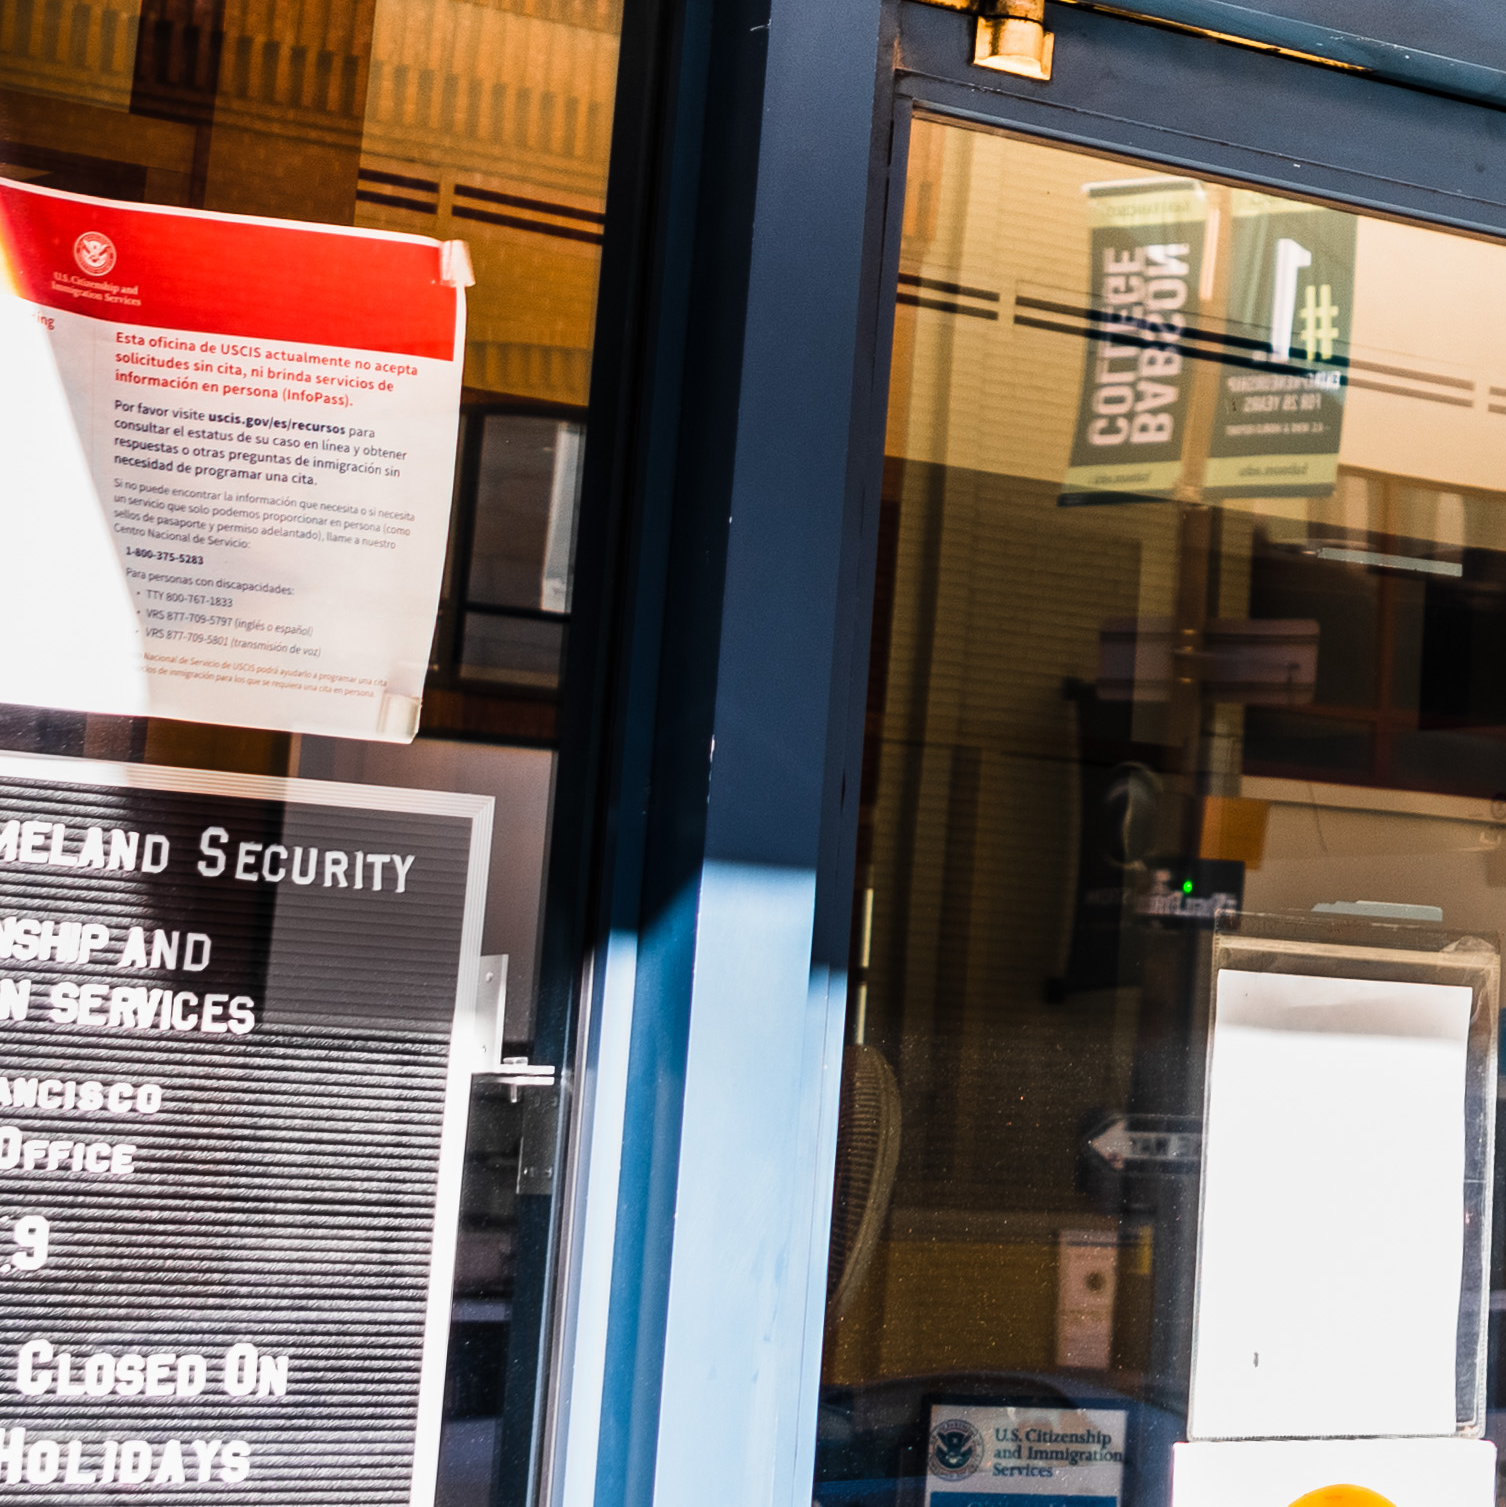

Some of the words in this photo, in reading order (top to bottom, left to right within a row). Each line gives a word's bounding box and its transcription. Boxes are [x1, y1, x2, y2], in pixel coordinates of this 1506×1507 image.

[105, 295, 141, 306] Services
[121, 286, 138, 295] and
[115, 352, 189, 370] solicitudes
[193, 361, 213, 372] sin
[217, 362, 247, 378] cita,
[251, 367, 263, 377] ni
[268, 367, 311, 383] brinda
[316, 375, 374, 389] servicios
[378, 380, 394, 391] de
[116, 332, 145, 346] Esta
[149, 337, 196, 351] oficina
[200, 342, 217, 353] de
[221, 344, 261, 359] USCIS
[265, 350, 351, 368] actualmente
[355, 360, 371, 370] no
[375, 361, 418, 375] acepta
[115, 369, 198, 390] información
[202, 383, 218, 392] en
[222, 385, 278, 399] persona
[283, 387, 353, 408] (InfoPass).
[115, 400, 134, 412] Por
[138, 403, 169, 417] favor
[172, 408, 205, 421] visite
[208, 412, 346, 435] uscis.gov/es/recursos
[349, 427, 375, 438] para
[115, 419, 170, 434] consultar
[173, 427, 184, 437] el
[188, 429, 233, 441] estatus
[237, 432, 251, 443] de
[256, 436, 269, 445] su
[273, 437, 300, 447] caso
[304, 440, 318, 450] en
[322, 440, 350, 453] línea
[353, 446, 360, 456] y
[363, 446, 407, 460] obtener
[115, 437, 178, 454] respuestas
[182, 447, 189, 456] o
[193, 447, 225, 458] otras
[228, 449, 292, 464] preguntas
[295, 455, 310, 466] de
[313, 457, 381, 475] inmigración
[385, 466, 400, 477] sin
[114, 455, 173, 472] necesidad
[177, 462, 192, 473] de
[195, 466, 262, 480] programar
[266, 472, 288, 482] una
[292, 472, 317, 485] cita.
[114, 478, 123, 488] Si
[125, 482, 137, 490] no
[139, 484, 170, 494] puede
[172, 489, 221, 501] encontrar
[224, 492, 233, 501] la
[235, 493, 297, 507] información
[299, 501, 318, 510] que
[320, 503, 358, 515] necesita
[378, 510, 415, 522] necesita
[114, 495, 126, 504] un
[128, 496, 165, 509] servicio
[167, 503, 185, 512] que
[188, 505, 210, 514] solo
[212, 507, 260, 520] podemos
[262, 511, 328, 526] proporcionar
[344, 521, 381, 532] persona
[383, 524, 410, 536] (como
[114, 509, 141, 521] sellos
[143, 515, 155, 523] de
[157, 516, 206, 529] pasaporte
[209, 523, 215, 532] y
[217, 522, 258, 534] permiso
[327, 532, 352, 543] llame
[362, 538, 396, 549] nuestro
[114, 522, 145, 536] Centro
[148, 528, 190, 542] Nacional
[193, 533, 205, 544] de
[126, 546, 204, 565] 1-800-375-5283
[126, 568, 146, 579] Para
[149, 573, 193, 586] personas
[196, 578, 213, 587] con
[146, 589, 165, 600] TTY
[166, 592, 233, 608] 800-767-1833
[197, 827, 415, 893] SECURITY
[117, 927, 212, 972] AND
[49, 981, 255, 1035] SERVICES
[17, 1339, 207, 1396] CLOSED
[224, 1343, 289, 1399] ON
[994, 1445, 1022, 1459] and
[1027, 1446, 1122, 1465] Immigration
[995, 1428, 1022, 1442] U.S.
[1025, 1428, 1112, 1449] Citizenship
[993, 1463, 1053, 1477] Services
